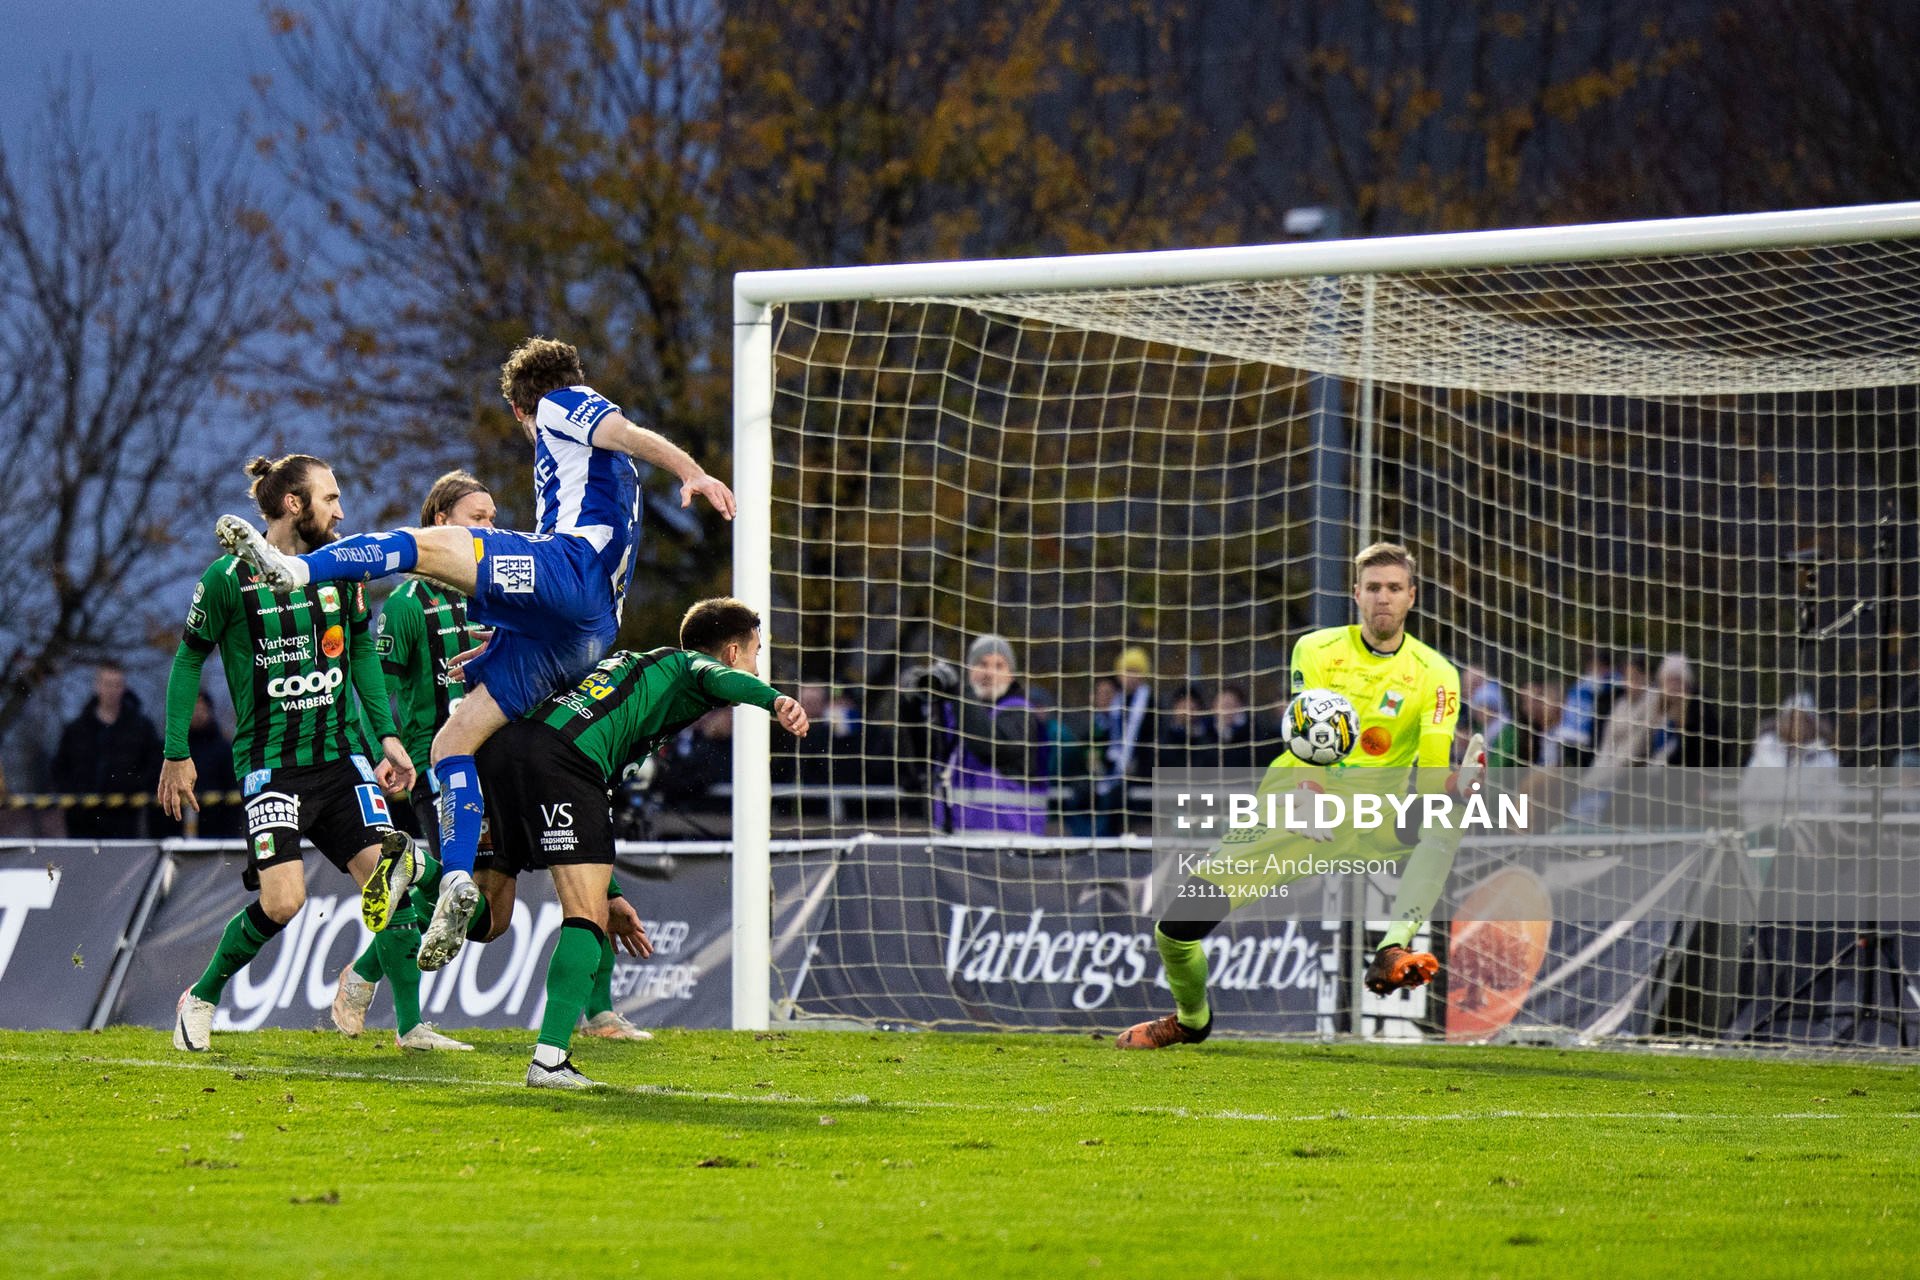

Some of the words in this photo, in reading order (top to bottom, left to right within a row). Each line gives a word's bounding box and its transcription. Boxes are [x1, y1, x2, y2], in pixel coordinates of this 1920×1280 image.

[508, 559, 520, 590] EKT
[520, 558, 532, 587] EFF
[258, 634, 310, 651] Varbergs
[255, 648, 312, 669] Sparbank
[281, 693, 335, 711] VARBERG
[540, 803, 574, 828] VS
[540, 837, 579, 845] STADSHOTELL
[543, 829, 574, 838] VARBERGS
[562, 844, 575, 852] SPA
[945, 904, 1151, 1010] Varbergs
